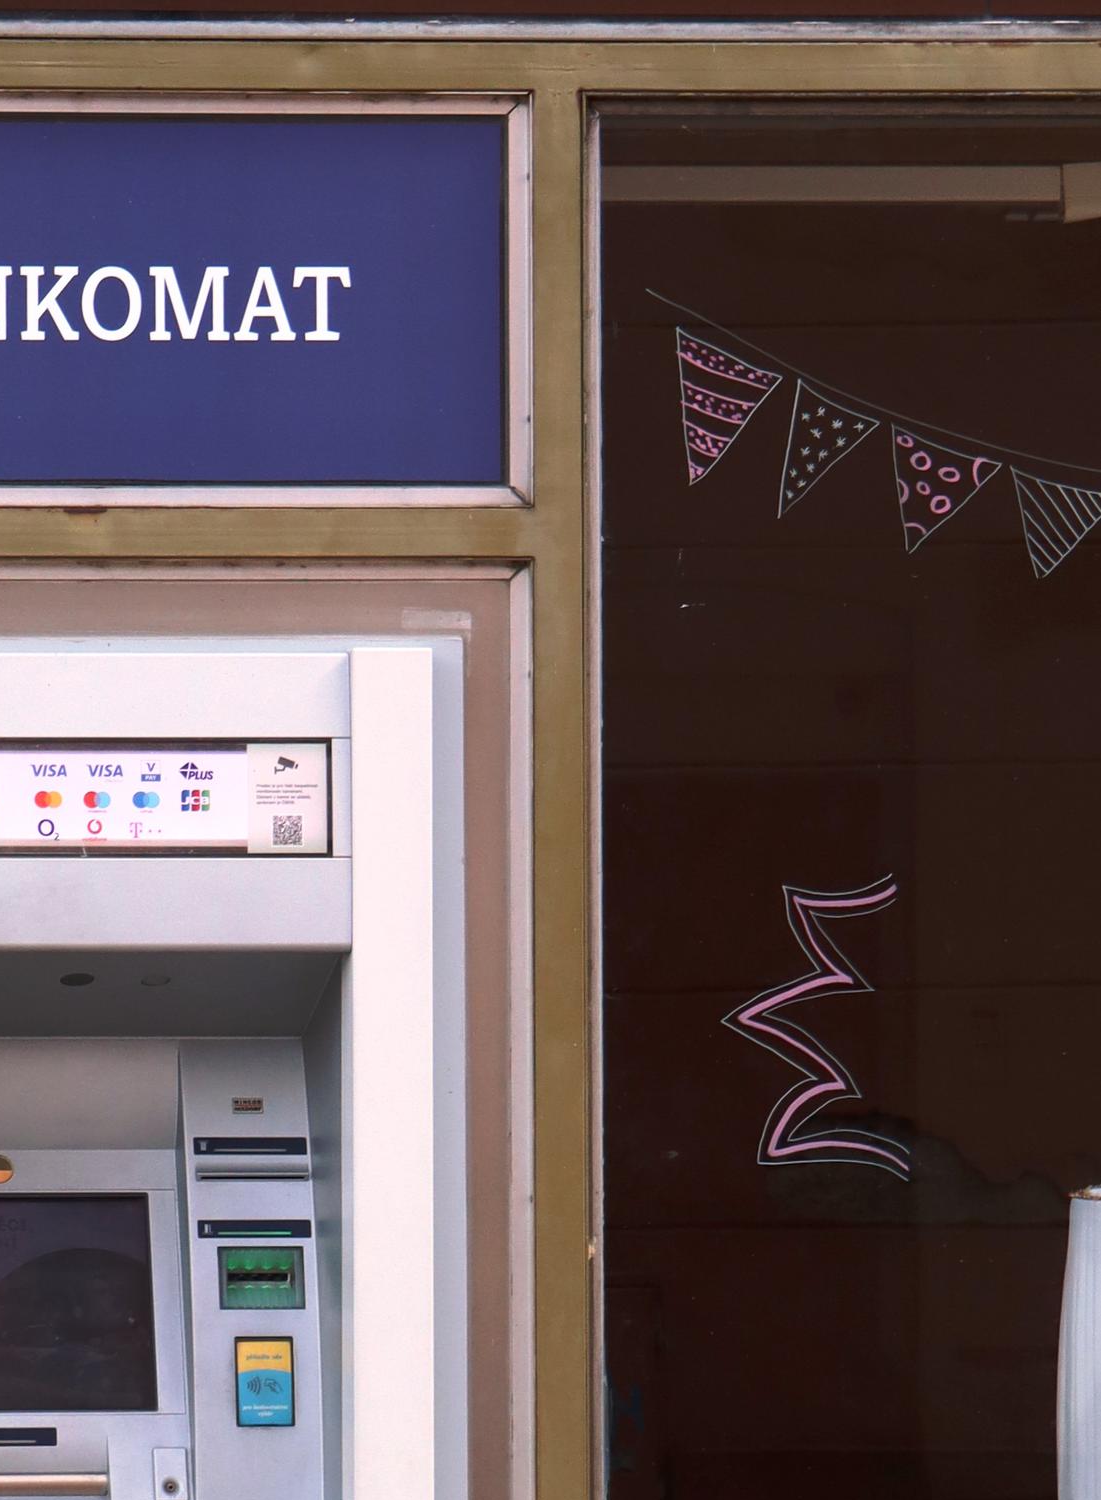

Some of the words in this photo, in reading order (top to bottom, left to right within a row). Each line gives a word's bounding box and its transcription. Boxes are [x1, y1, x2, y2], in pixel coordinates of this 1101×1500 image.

[31, 763, 68, 778] VISA
[87, 763, 124, 778] VISA
[187, 770, 214, 781] PLUS
